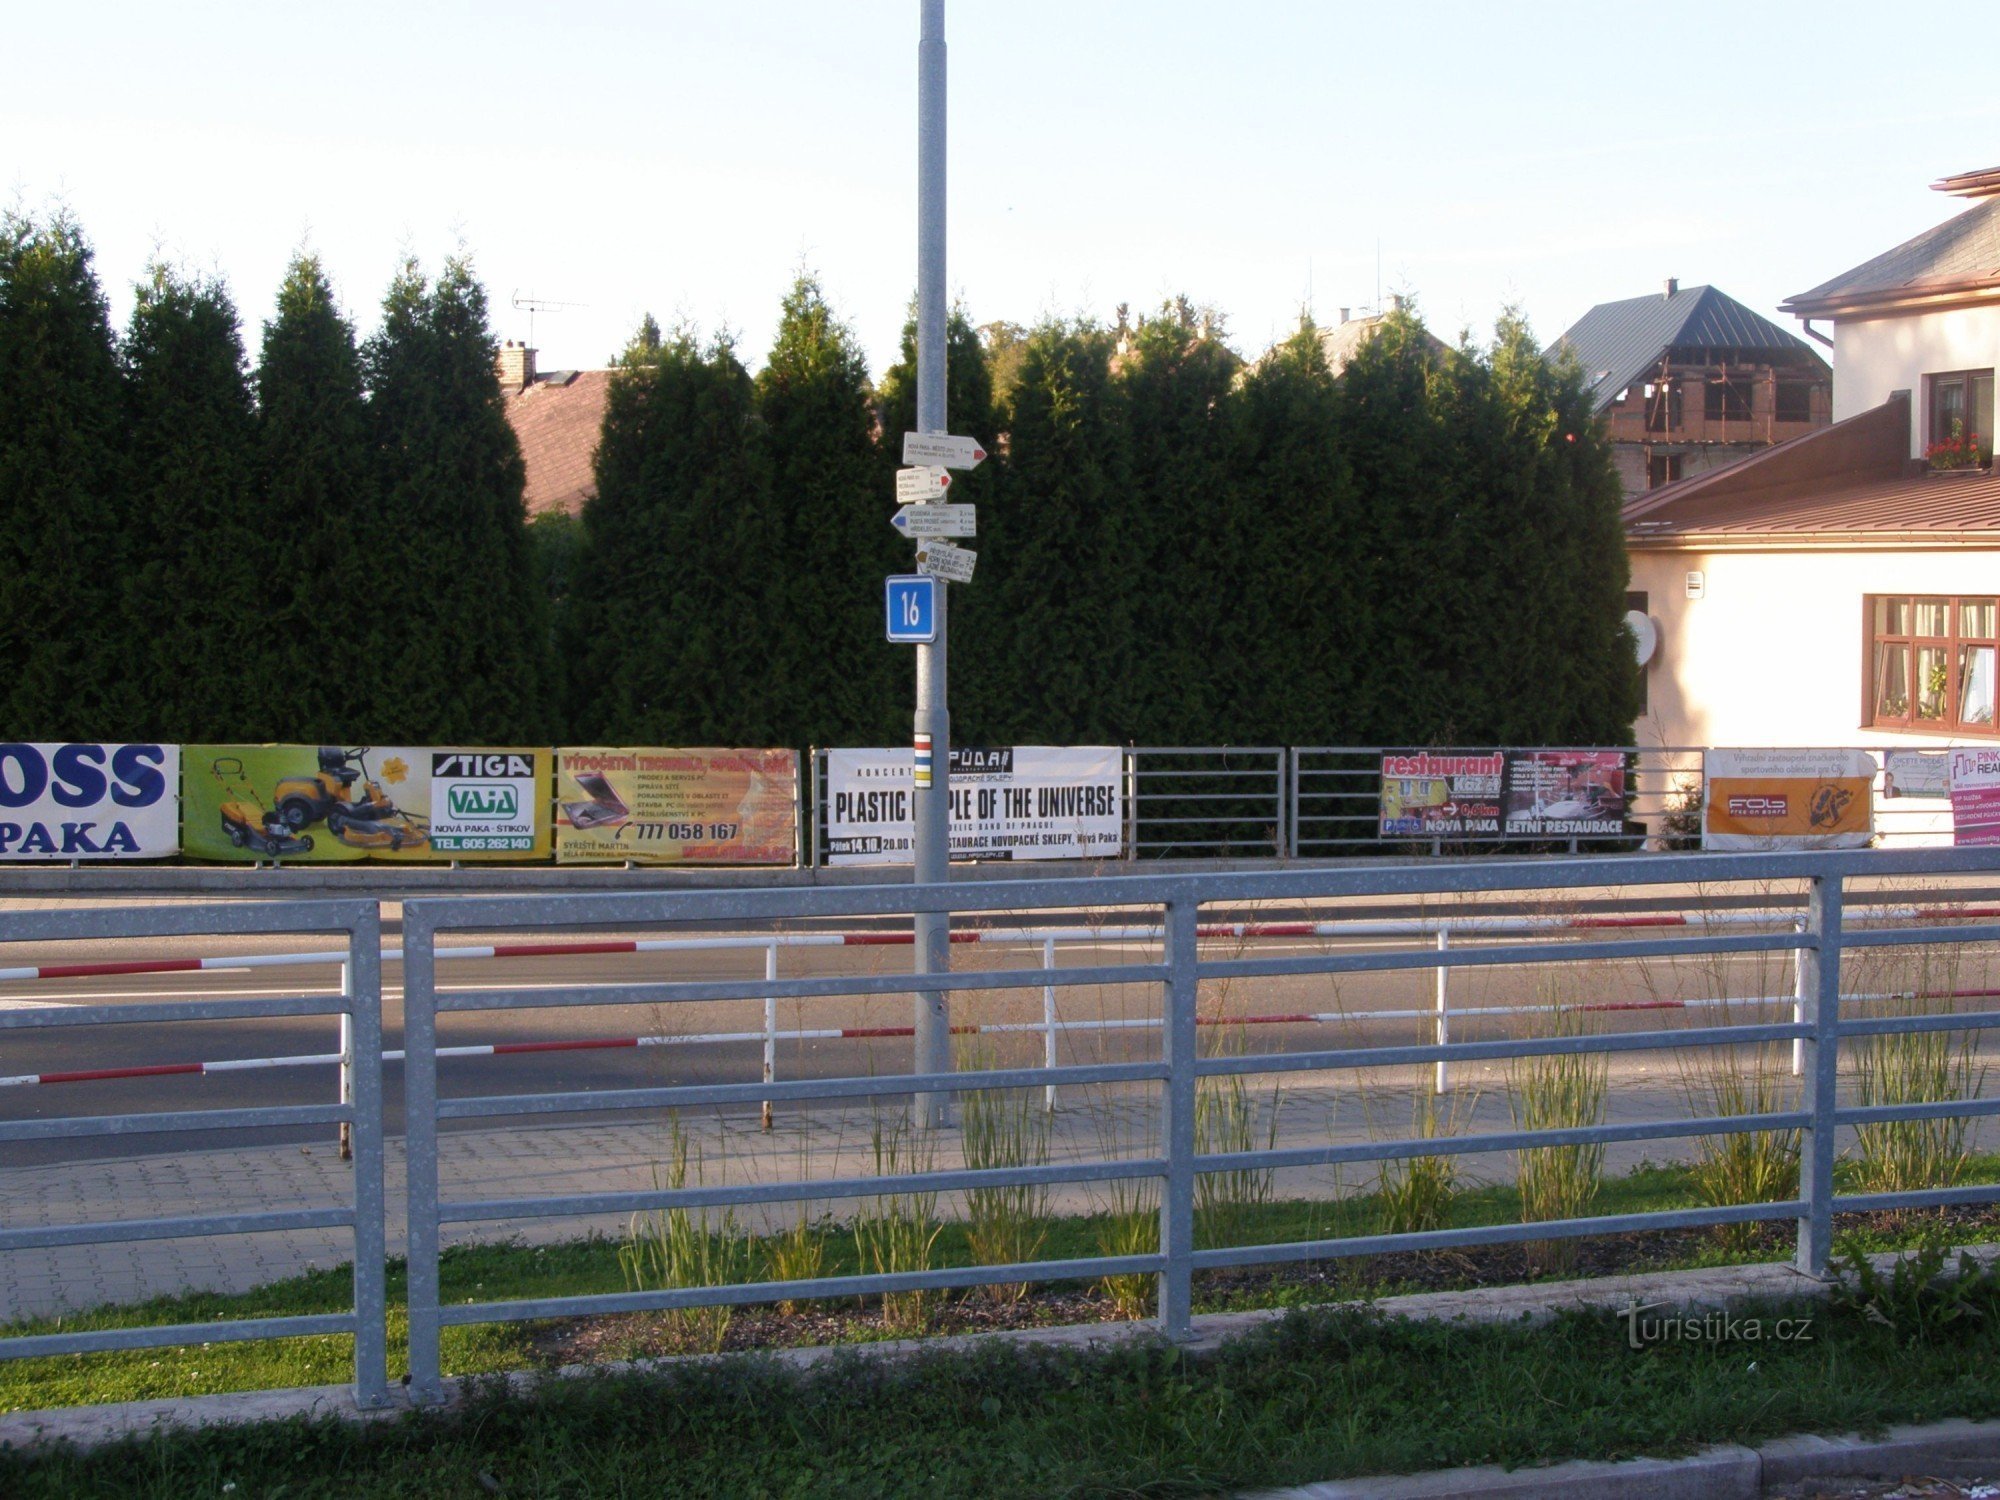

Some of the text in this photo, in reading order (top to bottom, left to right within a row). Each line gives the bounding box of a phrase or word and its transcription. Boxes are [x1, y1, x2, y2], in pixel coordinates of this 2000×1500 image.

[902, 590, 919, 626] 16
[1382, 752, 1504, 776] restaurant
[1978, 752, 2000, 762] PINK
[436, 755, 531, 776] STIGA
[858, 768, 912, 776] KONCERT
[836, 791, 906, 823] PLASTIC
[978, 788, 996, 819] OF
[1004, 788, 1032, 818] THE
[1038, 786, 1114, 818] UNIVERSE
[435, 824, 462, 832] NOVÁ
[637, 824, 738, 840] 777 058 167
[1546, 820, 1622, 832] RESTAURACE
[0, 822, 141, 853] PAKA
[462, 838, 486, 849] 605
[487, 838, 510, 849] 262
[510, 838, 530, 849] 140
[992, 832, 1039, 848] NOVOPACKÉ
[1042, 834, 1074, 846] SKLEPY,
[1098, 832, 1118, 843] Paka
